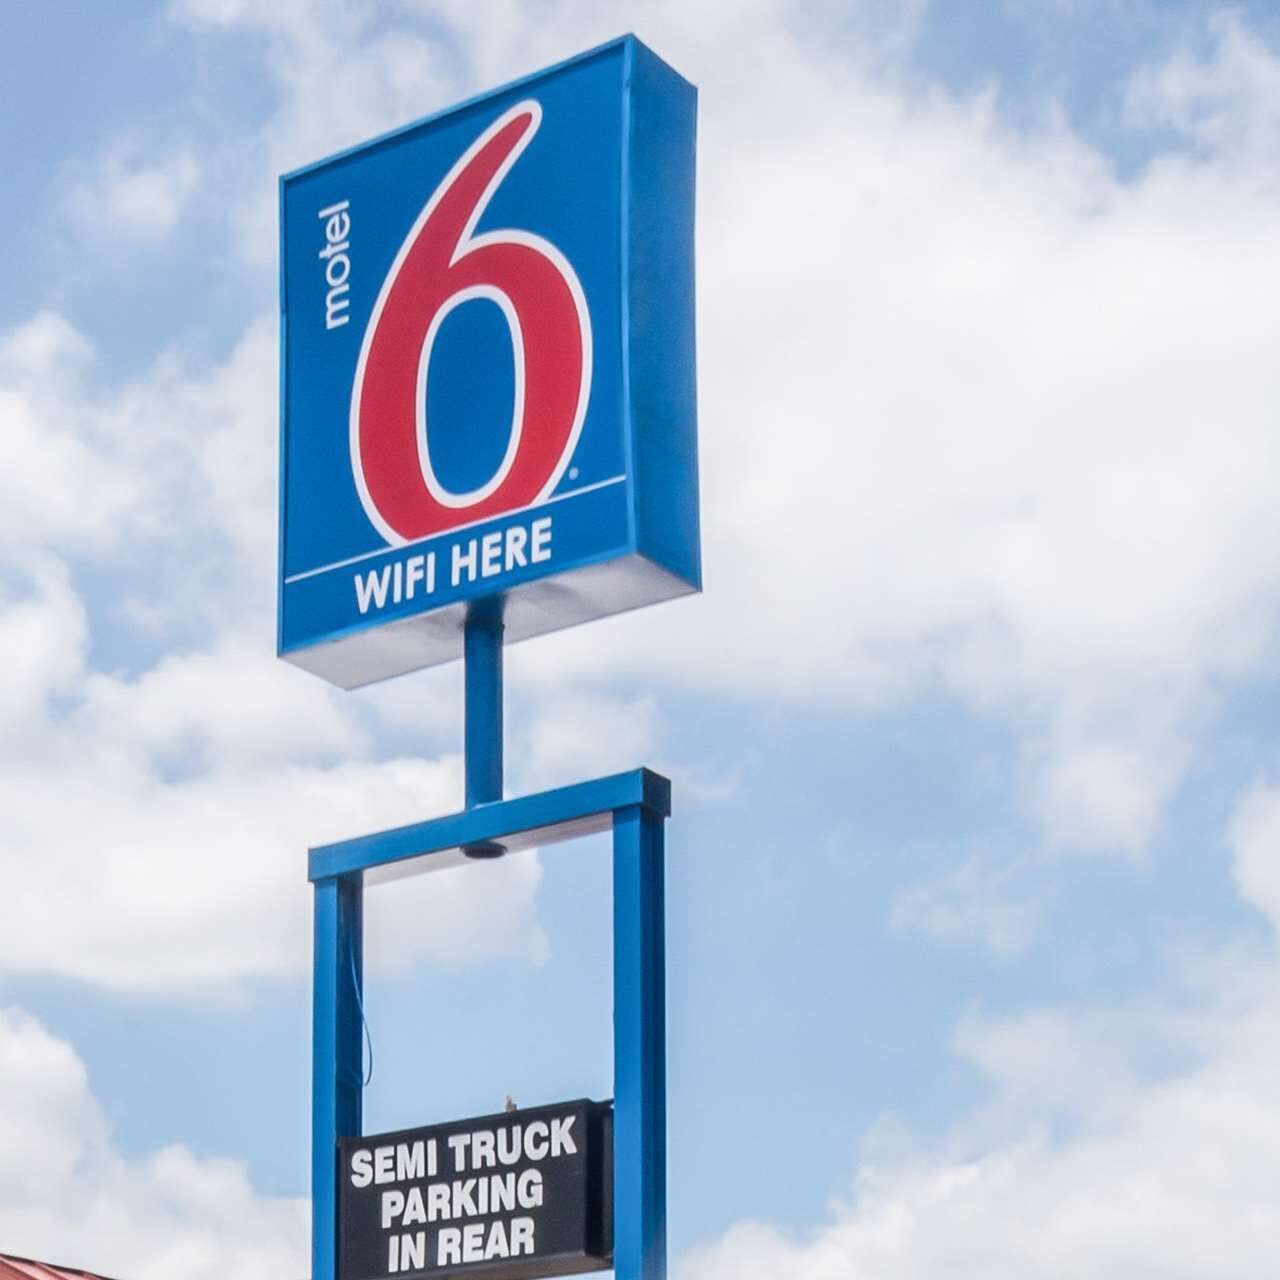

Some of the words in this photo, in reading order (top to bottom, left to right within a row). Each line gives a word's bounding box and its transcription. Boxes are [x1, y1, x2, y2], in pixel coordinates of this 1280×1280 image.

[319, 199, 350, 329] motel
[349, 98, 593, 549] 6
[354, 553, 435, 614] WIFI
[451, 517, 553, 587] HERE
[351, 1138, 438, 1188] SEMI
[448, 1115, 577, 1173] TRUCK
[381, 1168, 544, 1229] PARKING
[388, 1231, 425, 1274] IN
[437, 1216, 535, 1267] REAR
